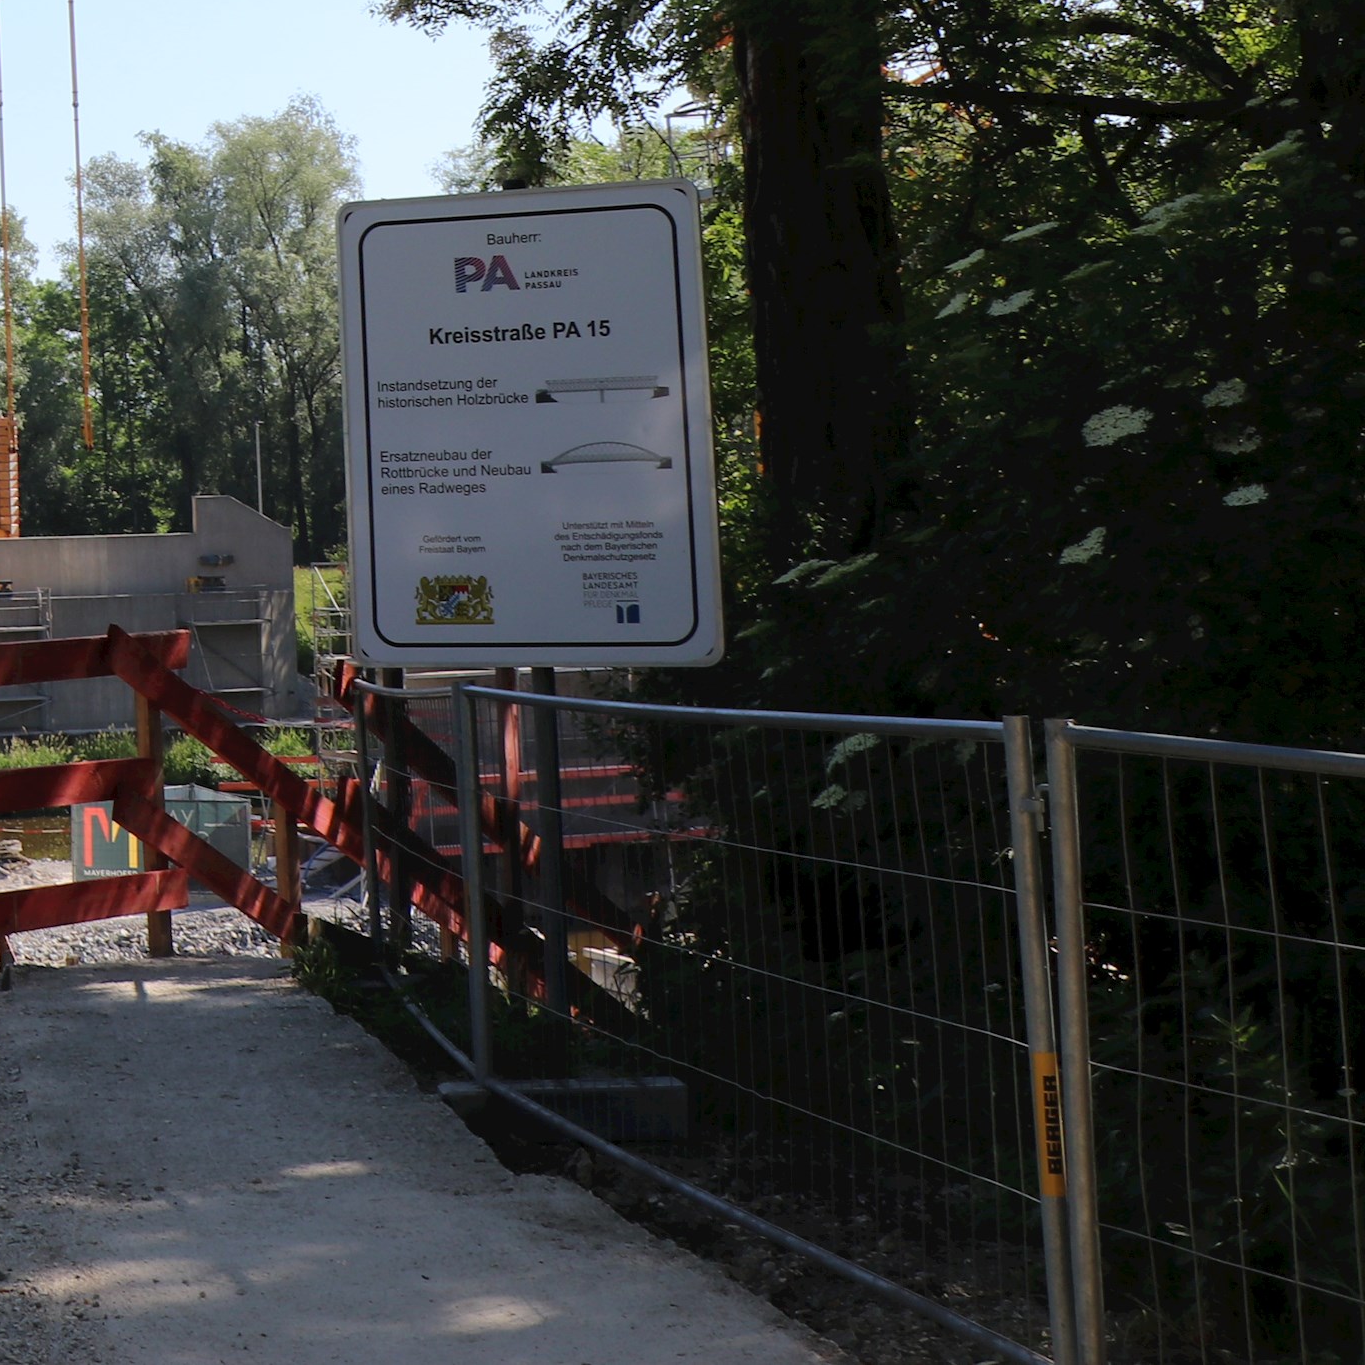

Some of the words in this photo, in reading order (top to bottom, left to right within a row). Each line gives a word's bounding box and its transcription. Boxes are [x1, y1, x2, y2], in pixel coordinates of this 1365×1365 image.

[487, 233, 542, 245] Bauherr:
[454, 255, 520, 293] PA
[524, 269, 579, 279] LANDKREIS
[525, 281, 562, 290] PASSAU
[429, 323, 546, 345] Kreisstraße
[553, 322, 581, 338] PA
[587, 320, 611, 337] 15
[377, 378, 473, 392] Instandsetzung
[476, 377, 498, 389] der
[378, 396, 452, 408] historischen
[457, 392, 529, 406] Holzbrücke
[380, 449, 467, 463] Ersatzneubau
[471, 448, 492, 460] der
[381, 466, 449, 479] Rottbrücke
[453, 465, 477, 477] und
[481, 464, 531, 476] Neubau
[381, 484, 415, 495] eines
[419, 482, 486, 496] Radweges
[554, 533, 570, 541] des
[456, 545, 486, 554] Bayern
[561, 543, 581, 551] nach
[584, 543, 603, 551] dem
[605, 541, 658, 552] Bayerischen
[563, 553, 656, 562] Denkmalschutzgesetz
[582, 572, 638, 580] BAYERISCHES
[583, 581, 638, 589] LANDESAMT
[1043, 1075, 1063, 1175] BERGER
